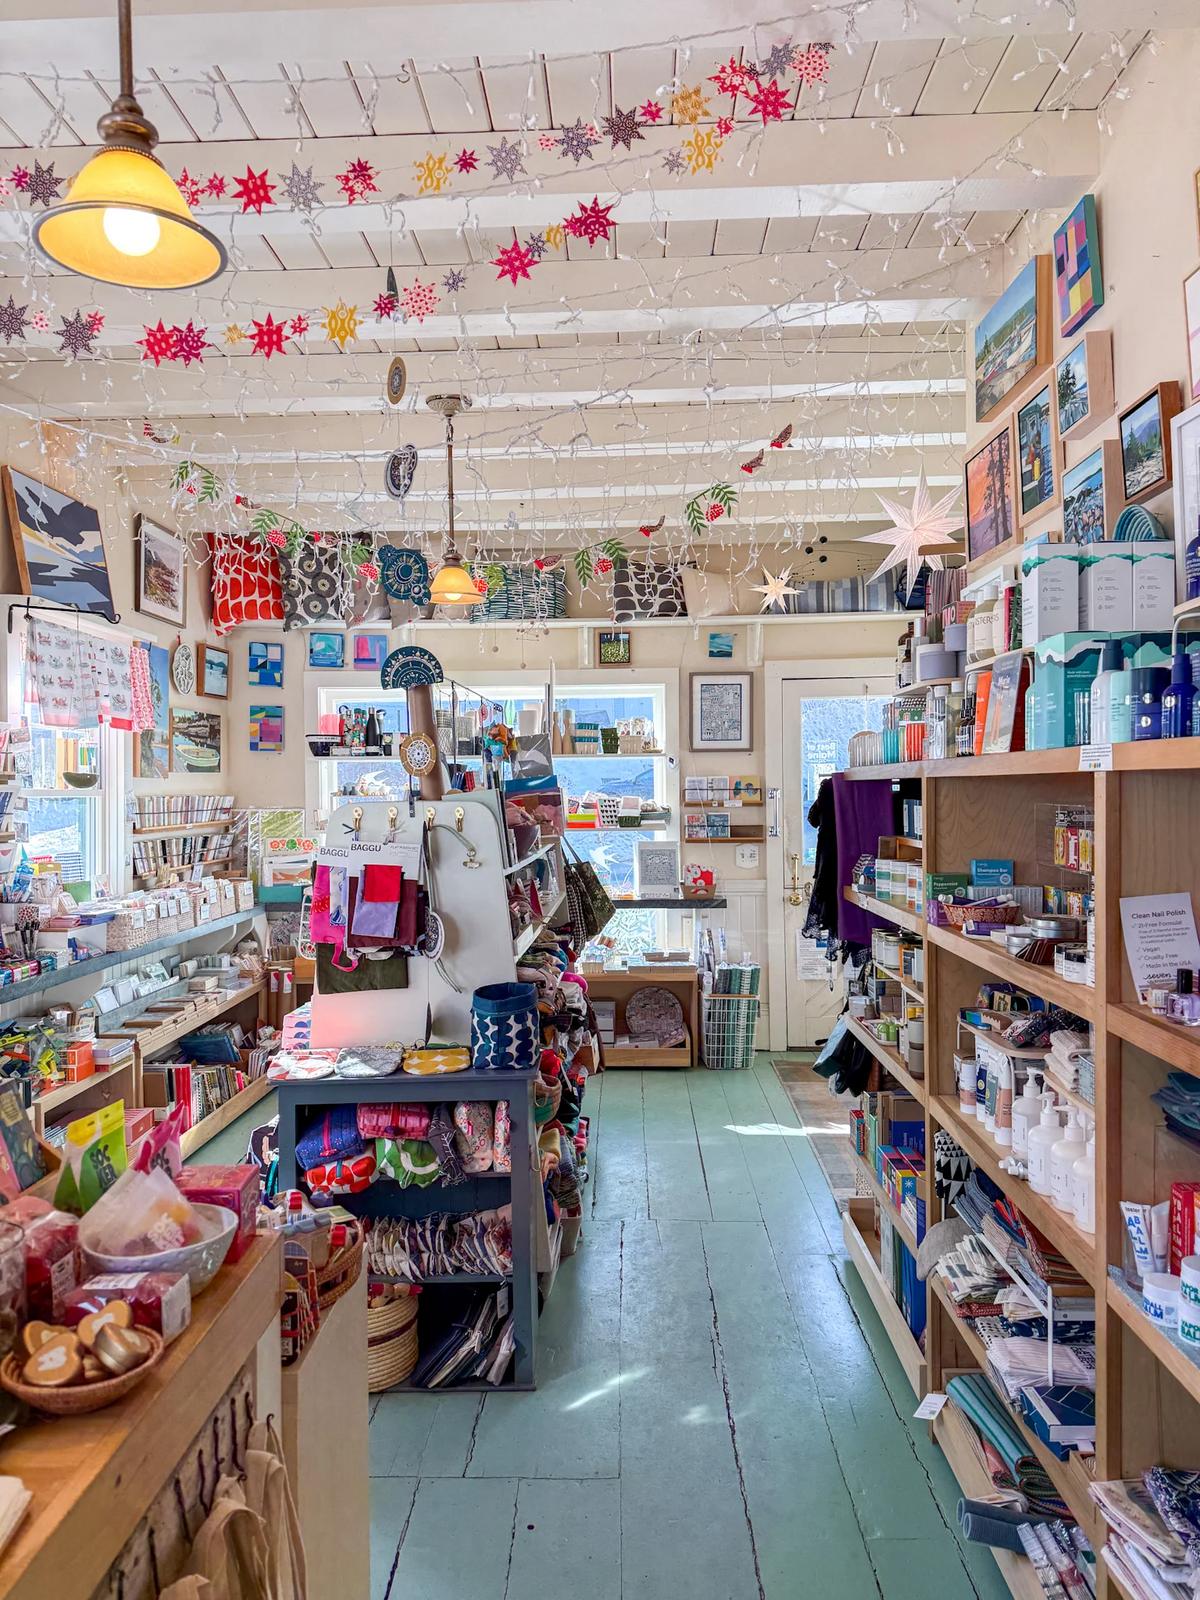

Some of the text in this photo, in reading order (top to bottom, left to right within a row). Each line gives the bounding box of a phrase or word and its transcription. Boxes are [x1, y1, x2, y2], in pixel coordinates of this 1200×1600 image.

[320, 847, 349, 858] BAGGU
[351, 843, 382, 852] BAGGU
[1131, 909, 1186, 920] Clean Nail Polish
